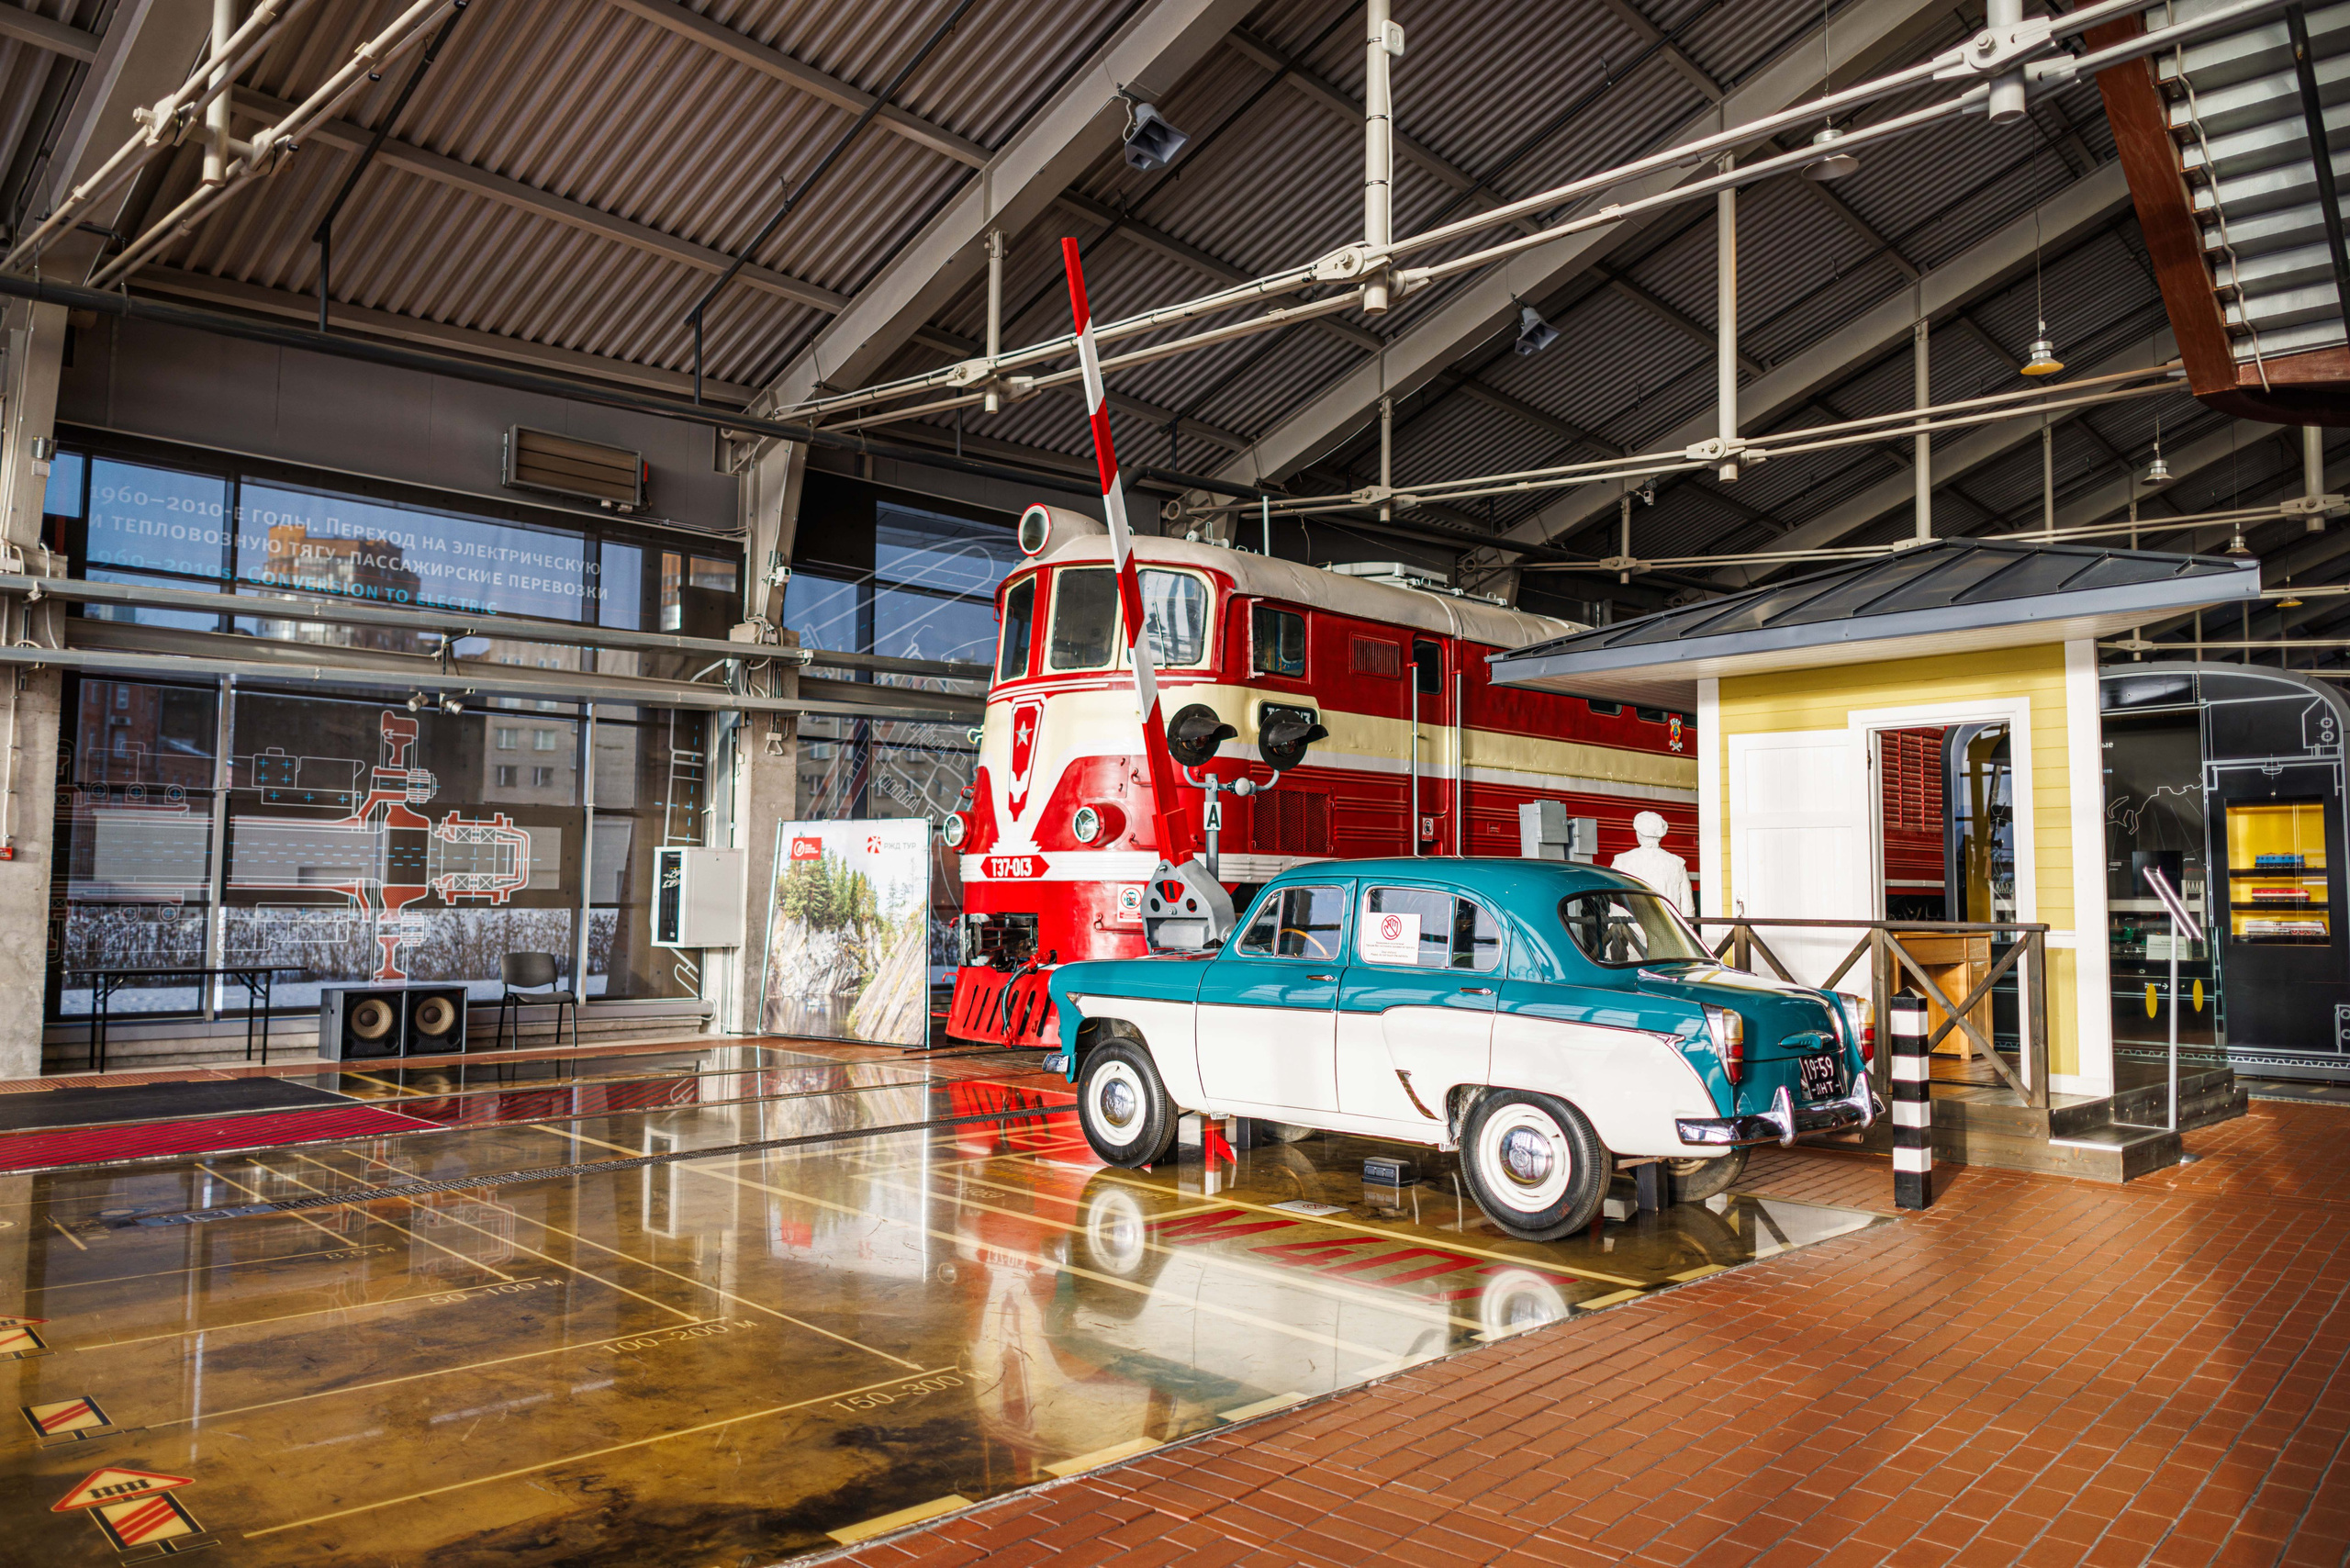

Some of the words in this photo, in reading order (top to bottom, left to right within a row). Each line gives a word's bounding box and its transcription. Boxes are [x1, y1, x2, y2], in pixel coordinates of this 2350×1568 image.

[111, 515, 283, 554] ТЕПЛОВОЗНУЮ
[288, 542, 342, 566] ТЯГУ,
[350, 551, 503, 586] ПАССАЖИРСКИЕ
[508, 574, 609, 600] ПЕРЕВОЗКИ
[252, 509, 319, 532] ГОДЫ.
[326, 517, 416, 550] ПЕРЕХОД
[421, 535, 447, 552] НА
[452, 541, 601, 576] ЭЛЕКТРИЧЕСКУЮ
[247, 566, 378, 599] CONVERSION
[385, 588, 409, 603] TO
[416, 591, 498, 615] ELECTRIC
